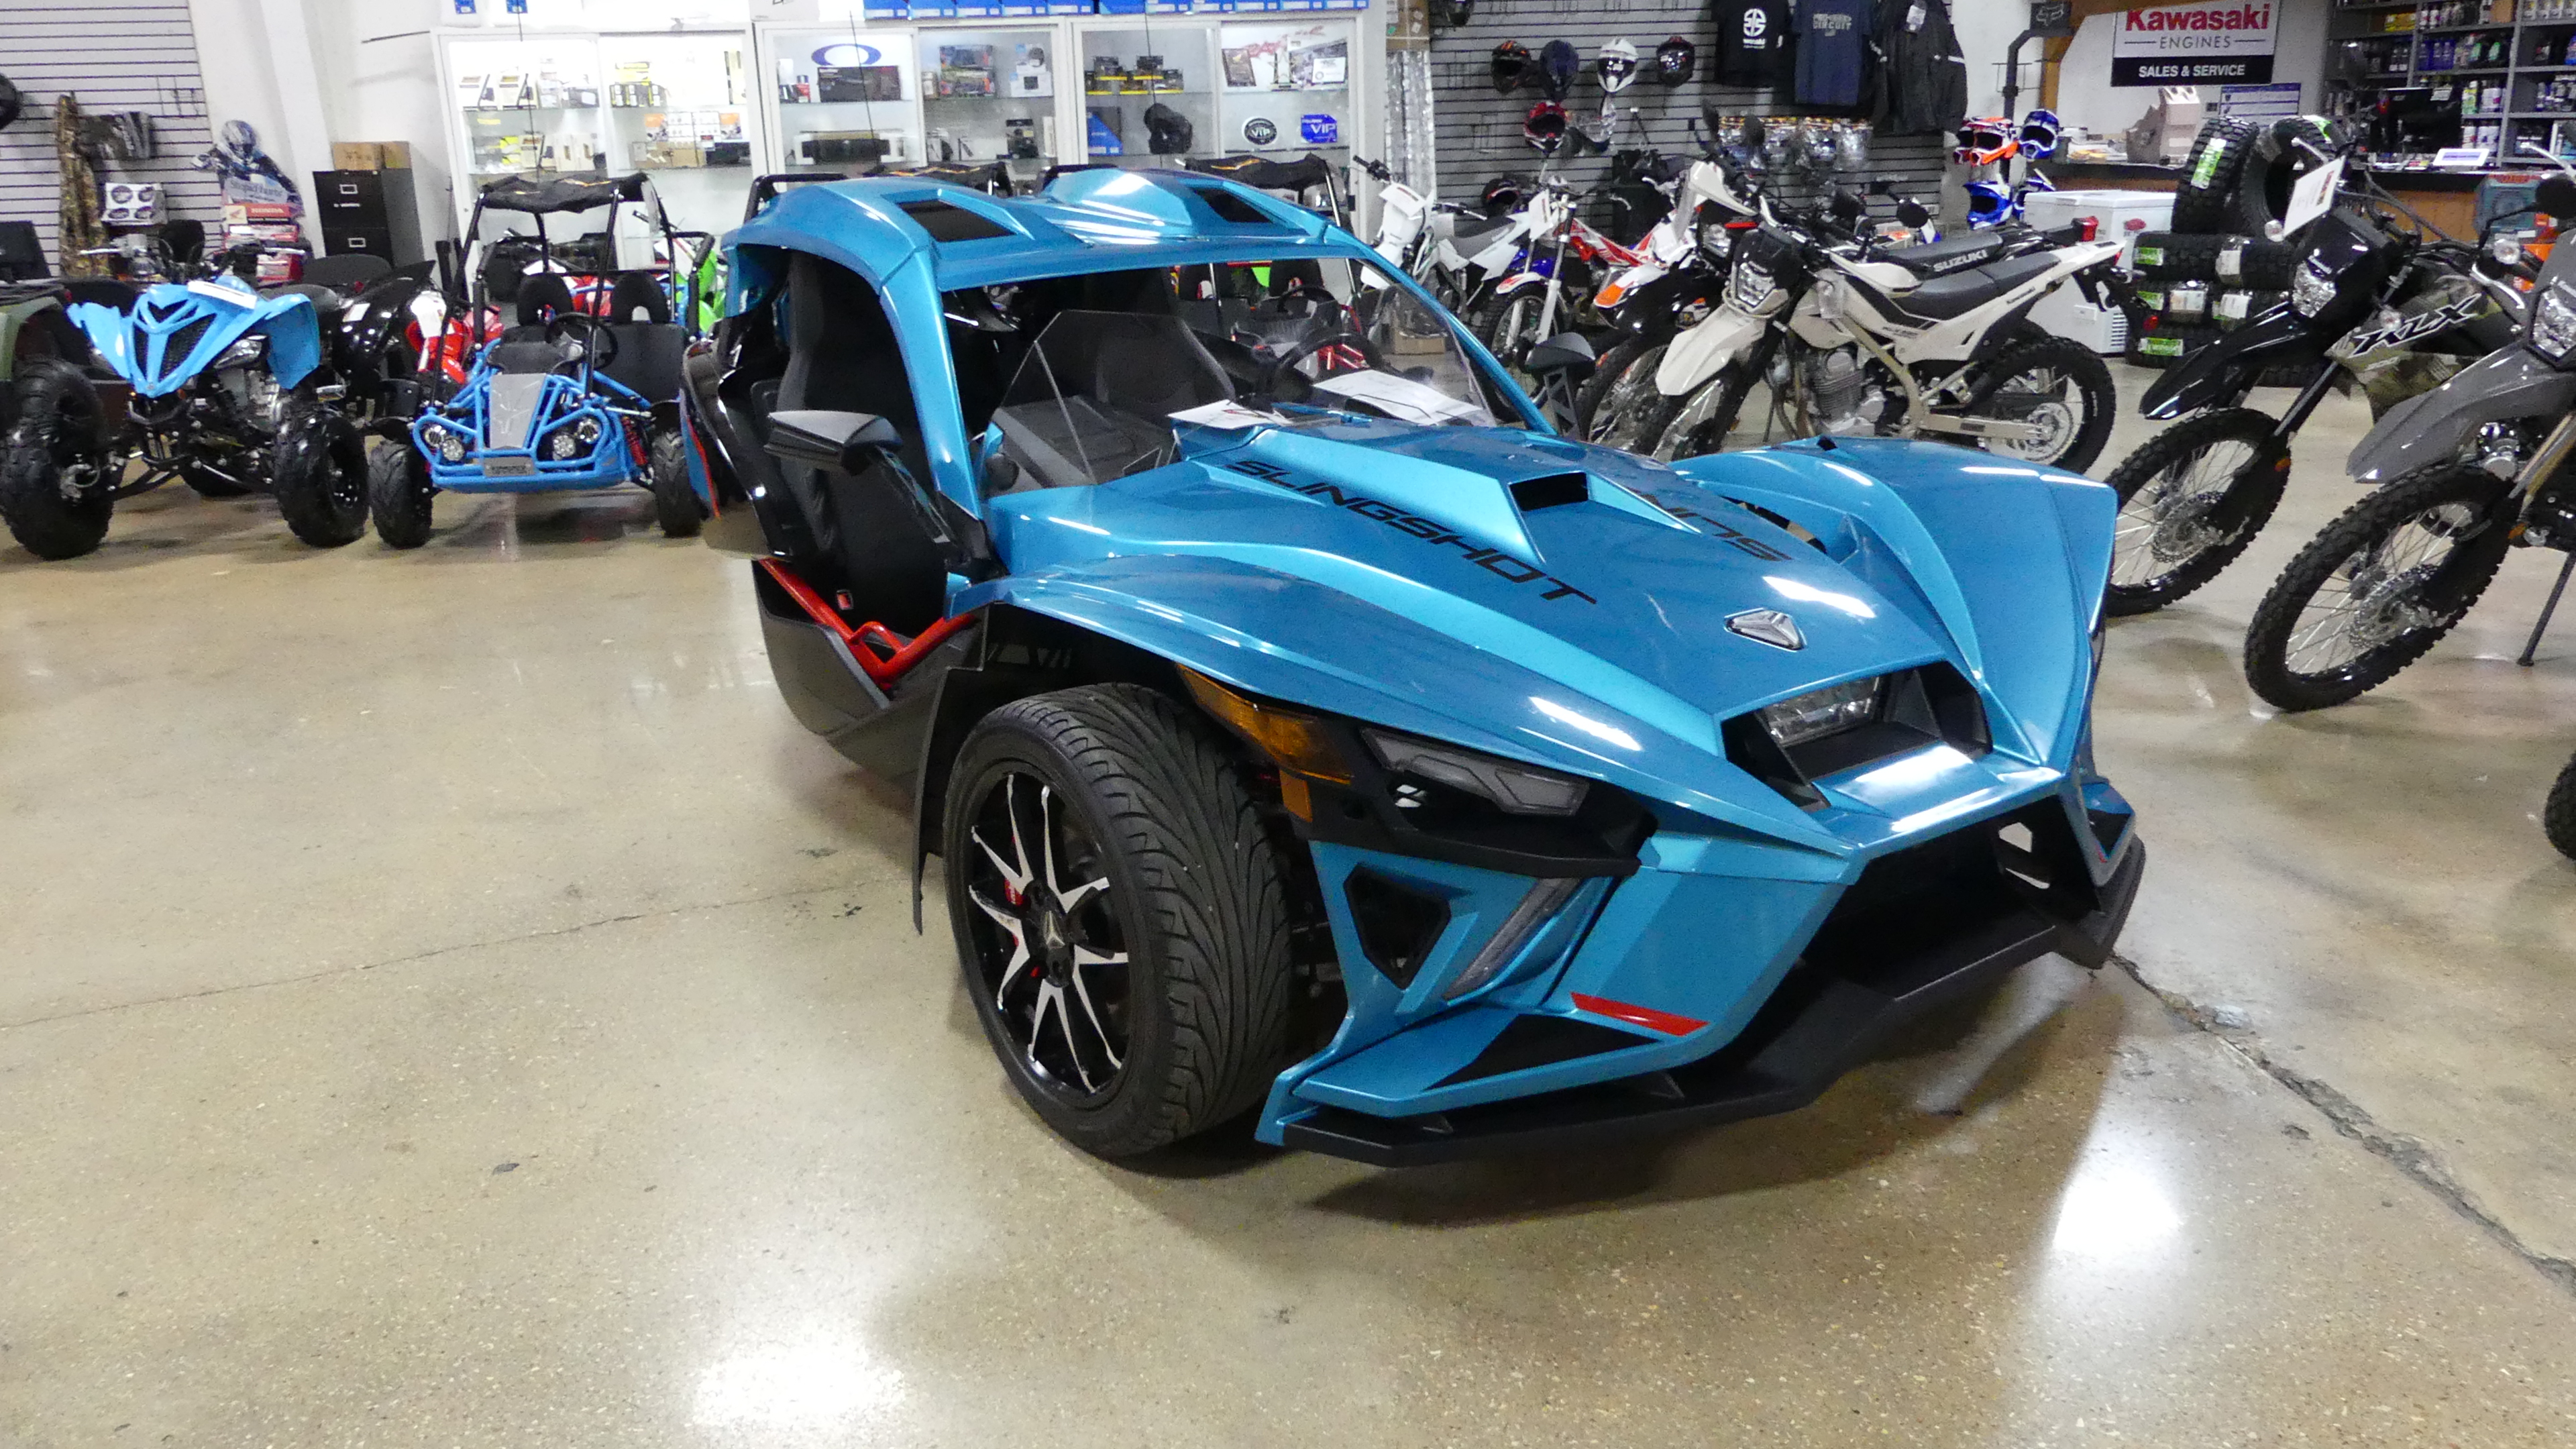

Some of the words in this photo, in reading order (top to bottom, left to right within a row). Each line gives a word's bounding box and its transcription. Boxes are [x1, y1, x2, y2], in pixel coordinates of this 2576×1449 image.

[2126, 3, 2270, 31] Kawasaki
[2159, 36, 2231, 49] ENGINES
[2139, 66, 2178, 78] SALES
[2181, 66, 2190, 77] &
[2192, 64, 2245, 77] SERVICE
[1251, 127, 1271, 137] VIP
[1311, 123, 1336, 134] VIP
[1933, 249, 1988, 272] SUZUKI
[1224, 460, 1597, 604] SLINGSHOT
